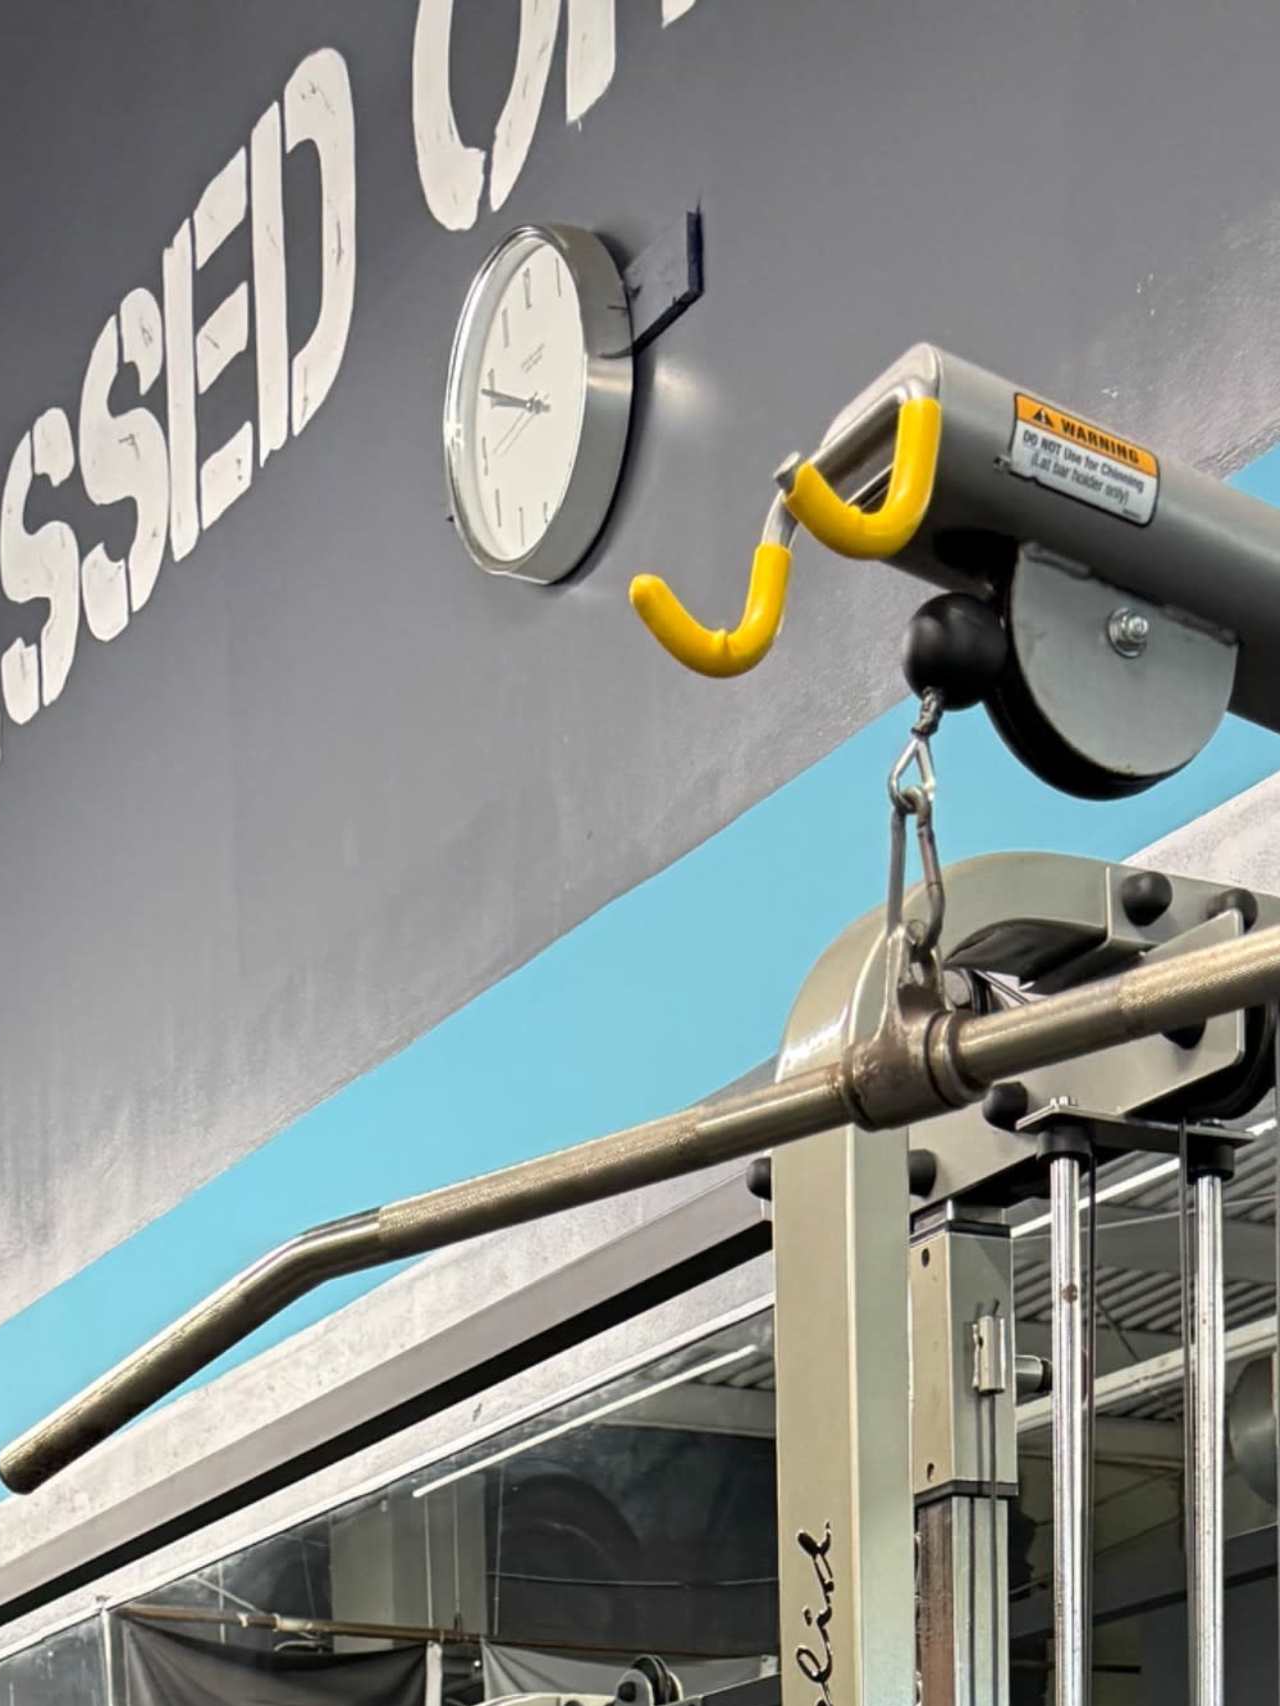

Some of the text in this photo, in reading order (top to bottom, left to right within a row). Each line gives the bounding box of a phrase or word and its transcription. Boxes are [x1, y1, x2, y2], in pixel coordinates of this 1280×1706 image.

[1023, 429, 1038, 447] DO
[1040, 437, 1061, 455] NOT
[1064, 446, 1082, 463] Use
[1084, 455, 1100, 471] for
[1060, 418, 1140, 463] WARNING
[1052, 462, 1069, 478] bar
[1071, 469, 1104, 492] holder
